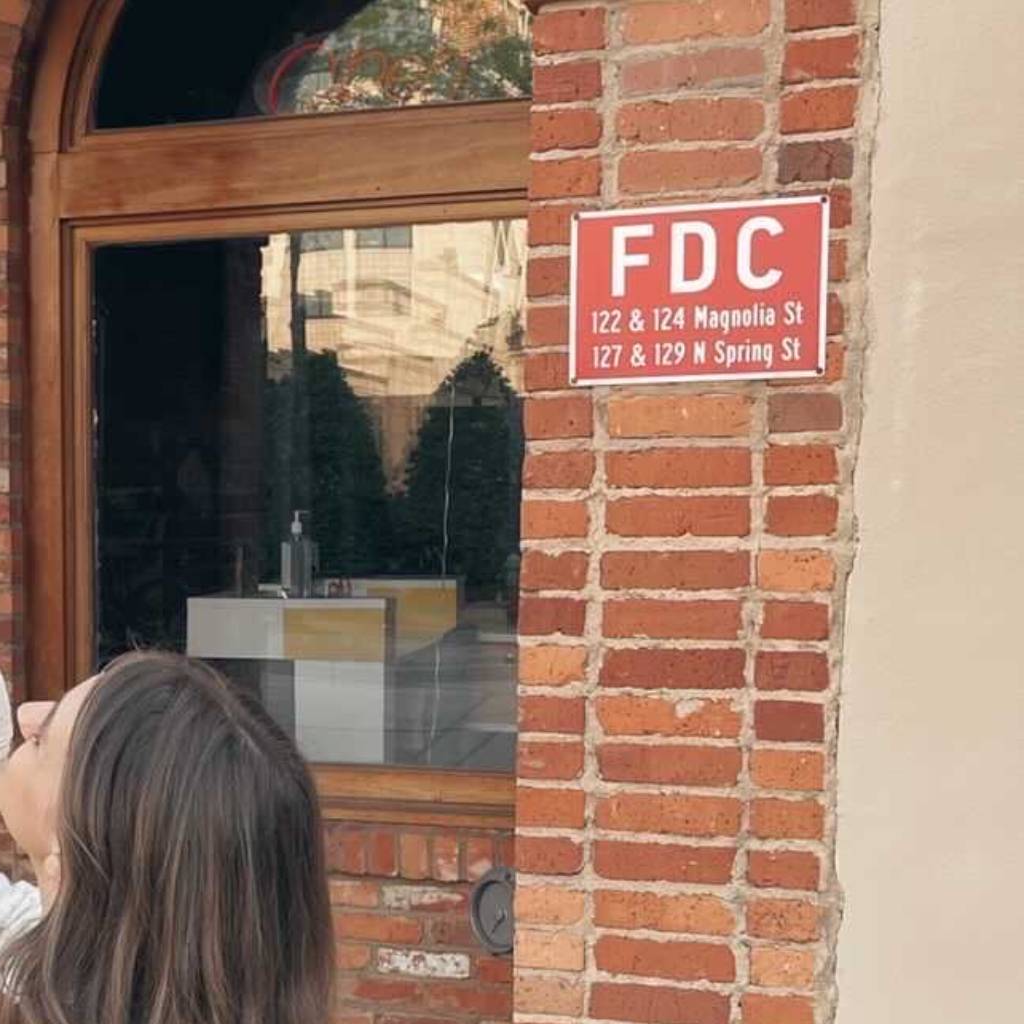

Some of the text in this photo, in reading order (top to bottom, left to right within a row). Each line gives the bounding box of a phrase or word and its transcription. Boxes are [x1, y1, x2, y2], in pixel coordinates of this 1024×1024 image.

[611, 216, 784, 298] FDC
[592, 301, 804, 334] 122 & 124 Magnolia St
[592, 337, 801, 369] 127 & 129 N Spring St
